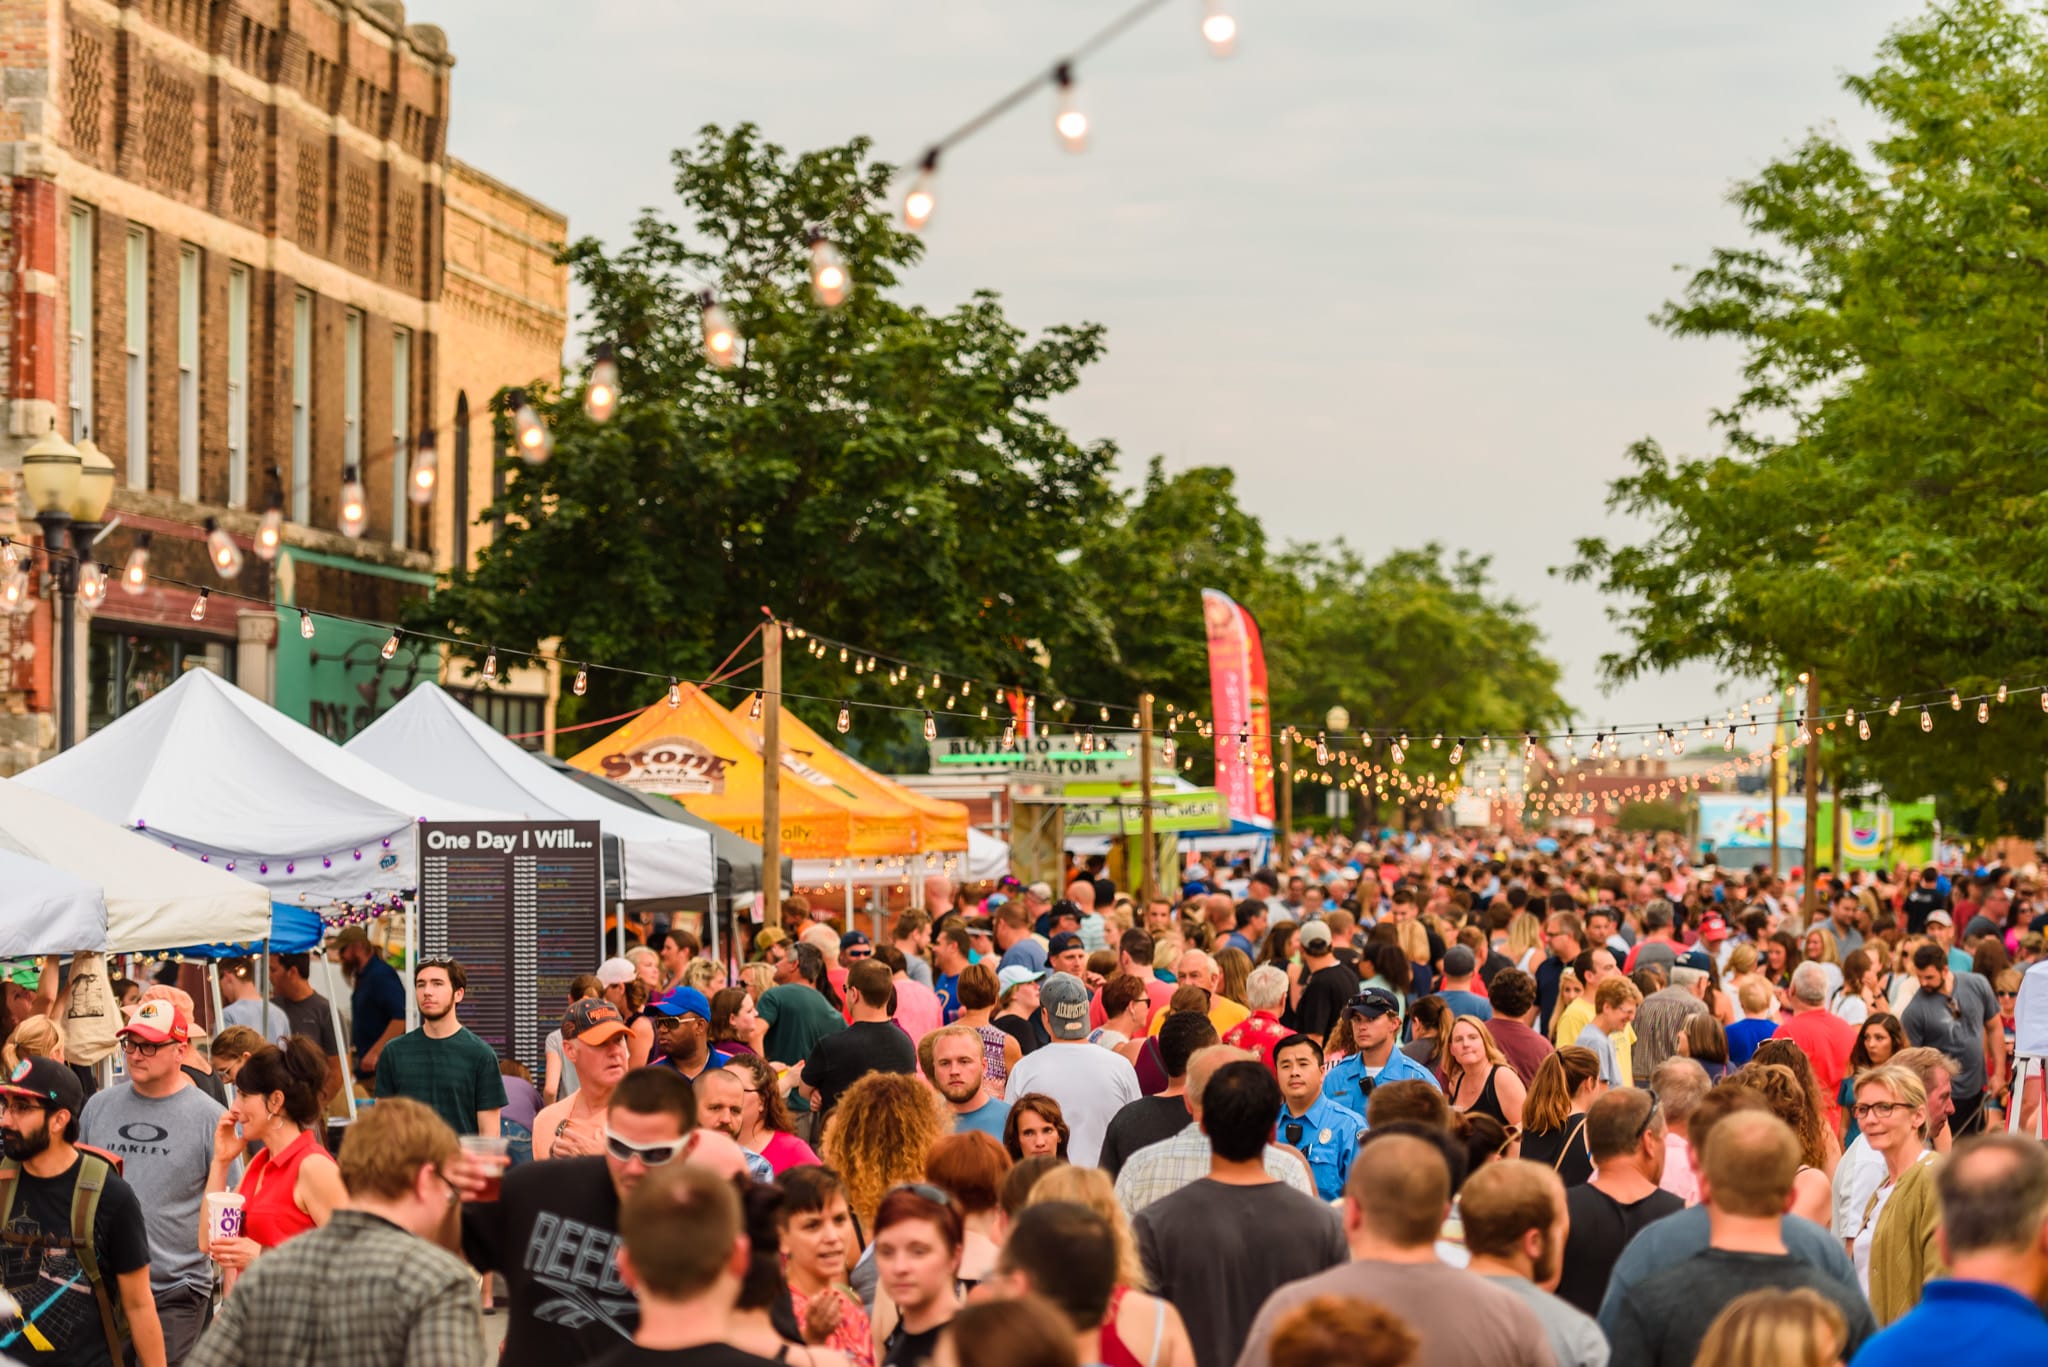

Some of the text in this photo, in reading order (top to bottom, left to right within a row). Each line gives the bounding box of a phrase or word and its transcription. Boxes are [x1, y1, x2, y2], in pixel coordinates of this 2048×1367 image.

[427, 831, 471, 849] One
[476, 831, 517, 853] Day
[522, 830, 529, 848] I
[107, 1143, 170, 1156] OAKLEY
